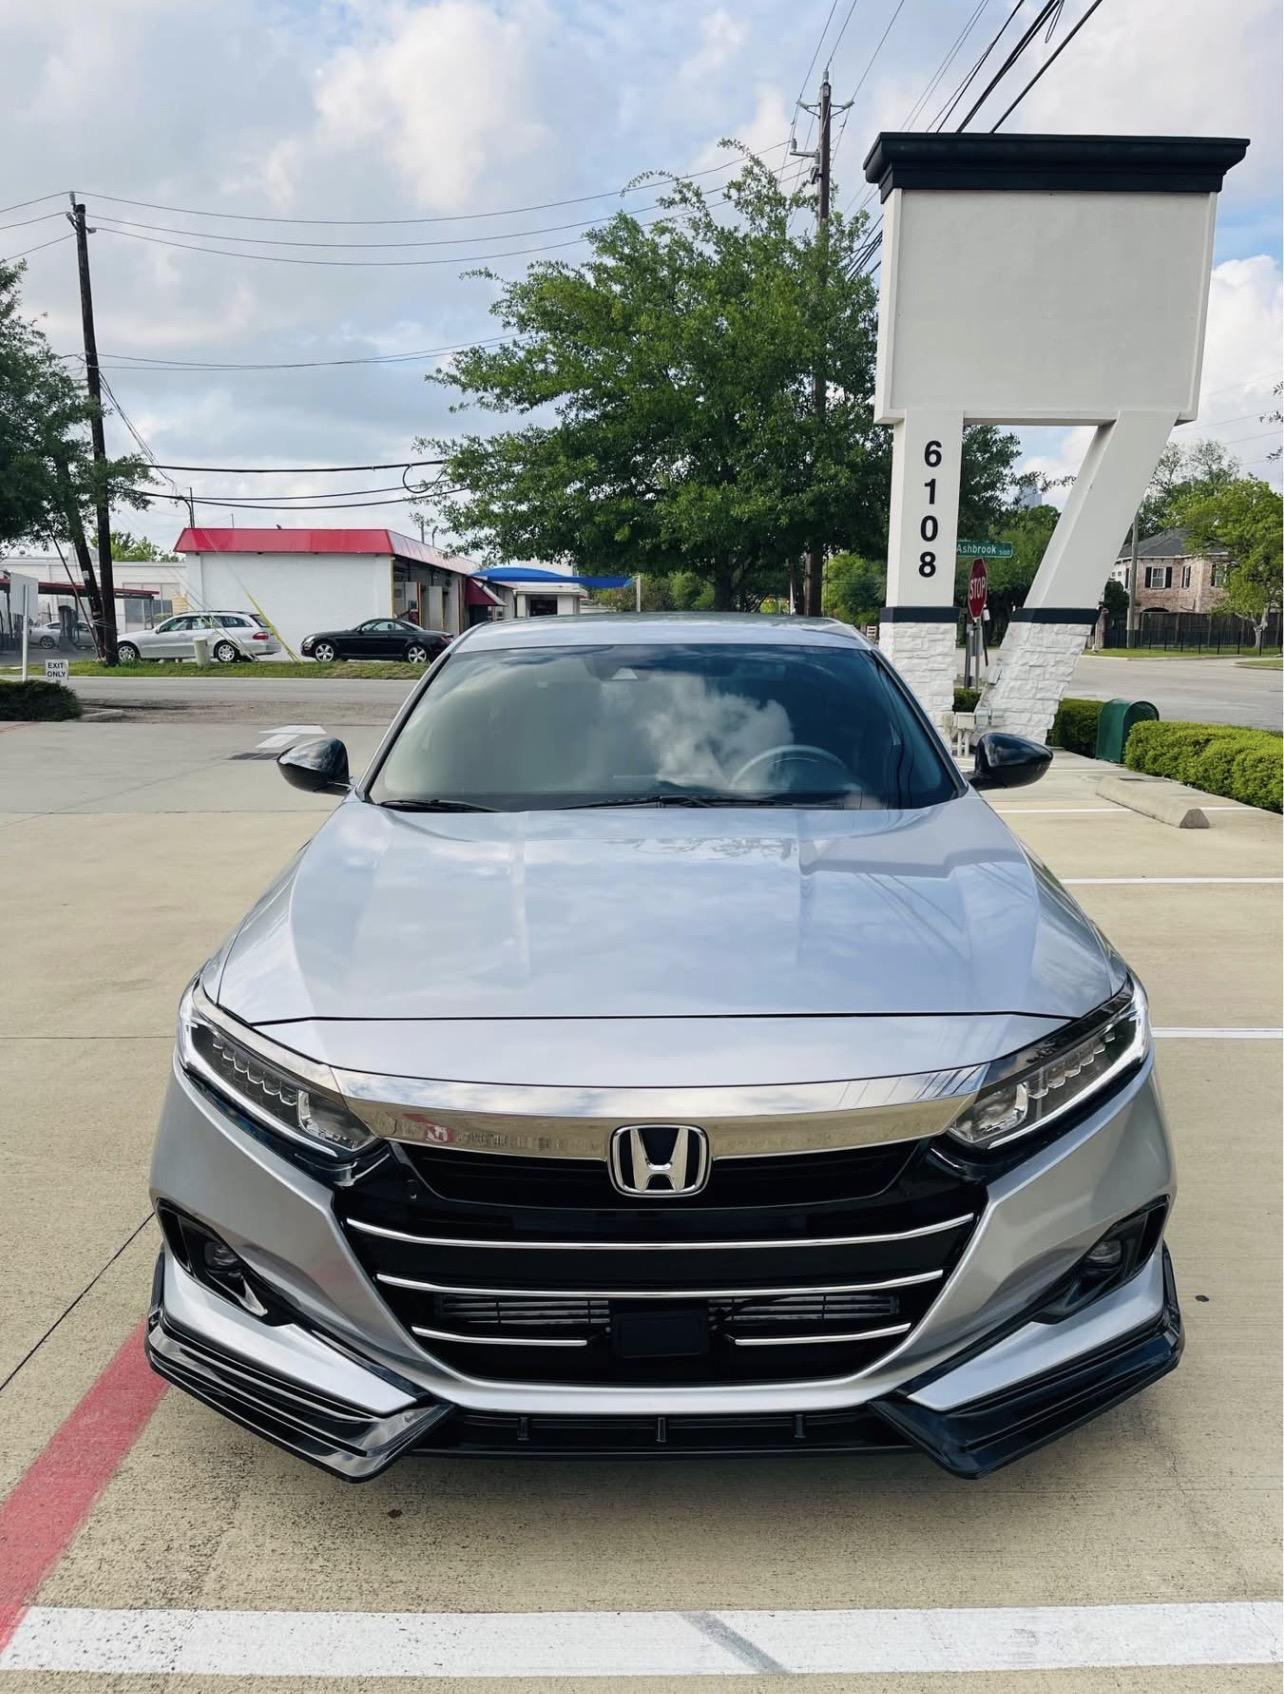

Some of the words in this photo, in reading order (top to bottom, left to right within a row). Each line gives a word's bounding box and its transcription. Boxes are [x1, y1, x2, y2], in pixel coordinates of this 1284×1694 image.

[918, 440, 942, 578] 6108
[956, 543, 997, 554] Ashbrook
[969, 576, 986, 600] STOP
